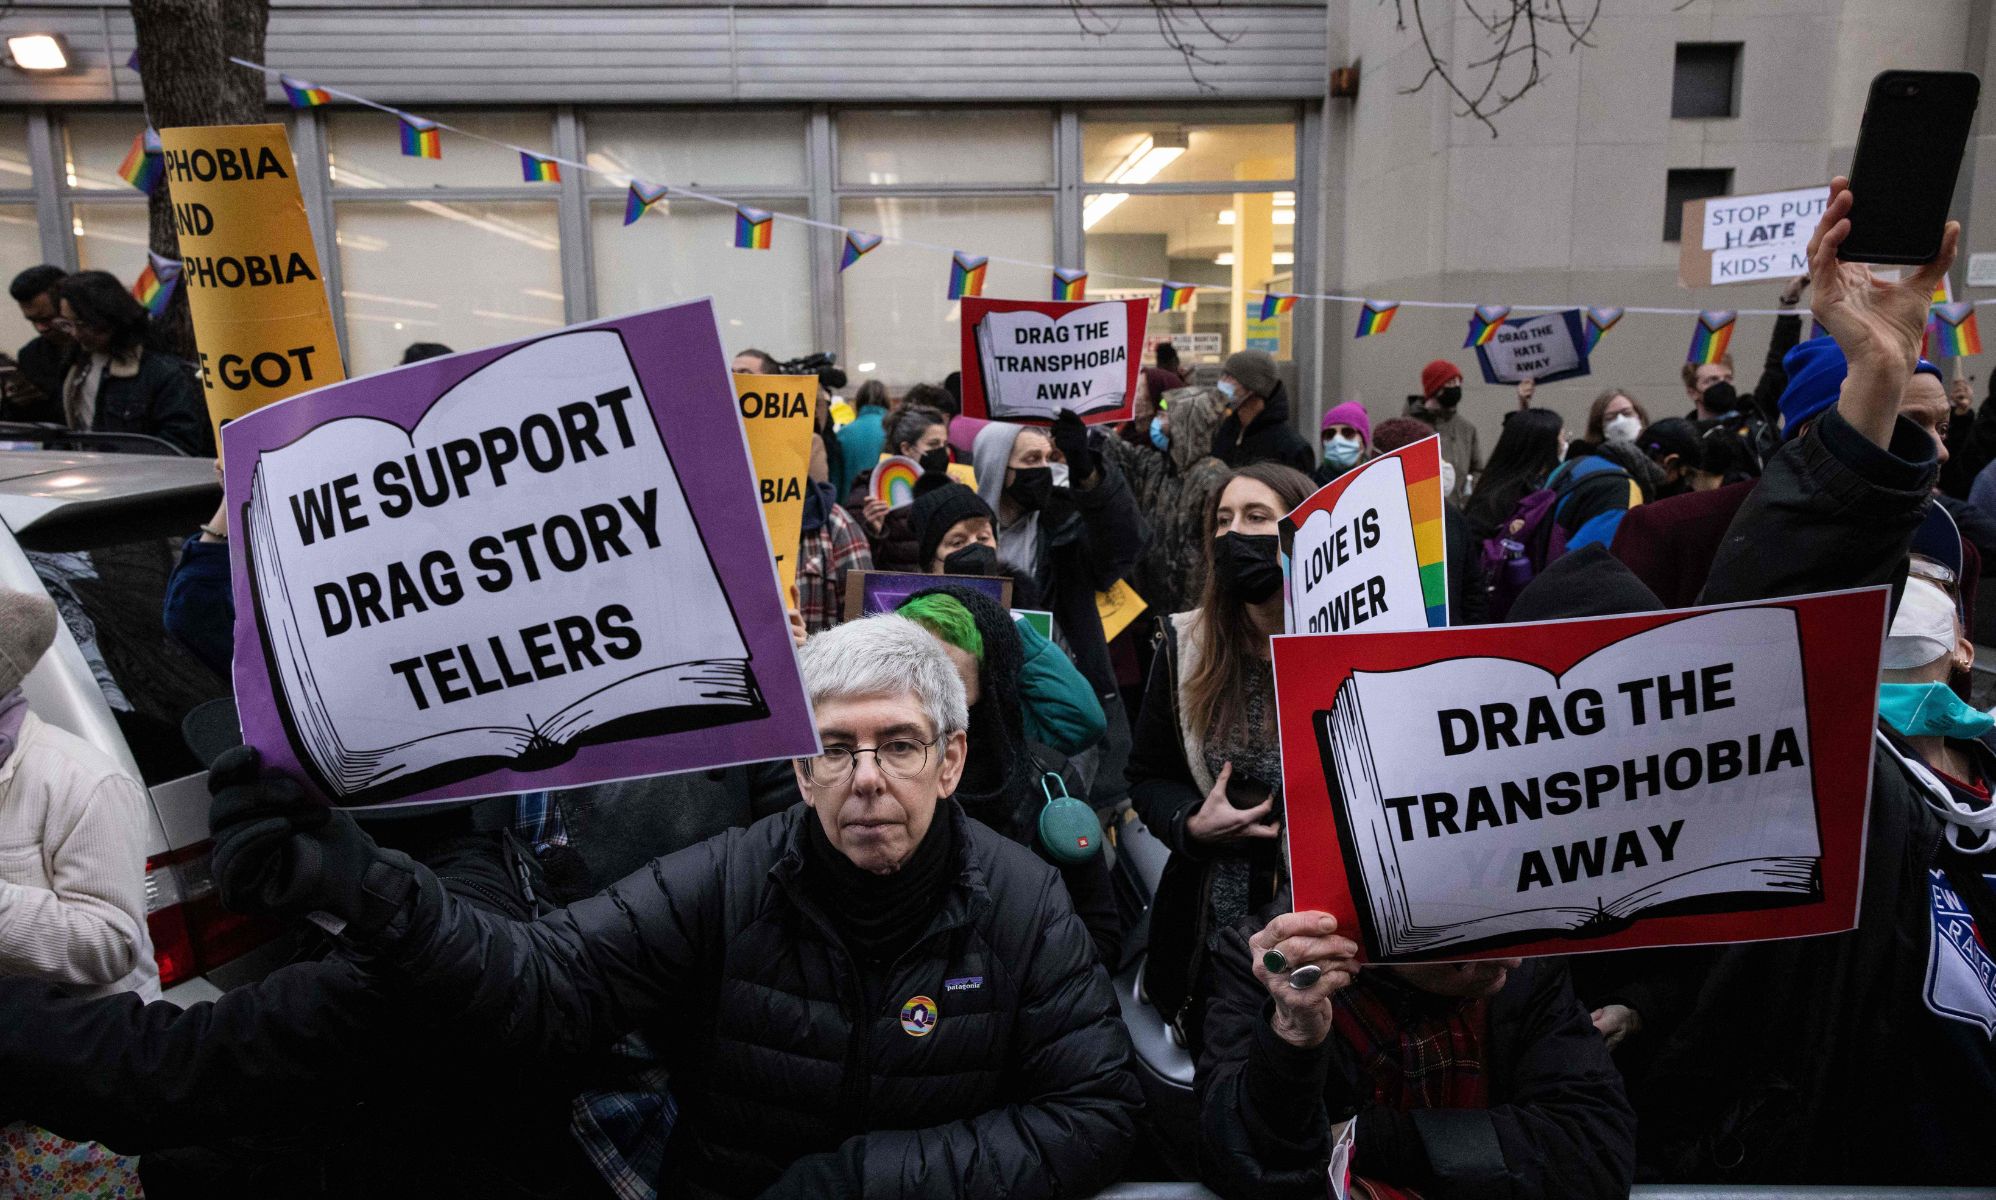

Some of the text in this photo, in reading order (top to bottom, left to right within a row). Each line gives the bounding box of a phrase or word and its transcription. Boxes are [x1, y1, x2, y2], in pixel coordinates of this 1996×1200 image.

[165, 147, 288, 182] PHOBIA
[174, 203, 214, 235] ND
[1713, 198, 1826, 226] STOP PUT
[1726, 222, 1795, 249] HATE
[182, 252, 317, 288] PHOBIA
[1720, 254, 1776, 276] KIDS'
[1015, 321, 1109, 344] DRAG THE
[1498, 324, 1553, 343] DRAG THE
[995, 346, 1125, 372] TRANSPHOBIA
[1513, 343, 1544, 357] HATE
[1516, 358, 1550, 371] AWAY
[219, 346, 316, 391] GOT
[740, 392, 808, 418] OBIA
[1036, 380, 1093, 400] AWAY
[289, 386, 636, 546] WE SUPPORT
[760, 477, 801, 503] BIA
[313, 488, 662, 637] DRAG STORY
[1305, 508, 1381, 593] LOVE IS
[1309, 575, 1389, 633] POWER
[390, 604, 642, 710] TELLERS
[1437, 662, 1735, 756] DRAG THE
[1384, 727, 1804, 842] TRANSPHOBIA
[1516, 819, 1685, 892] AWAY
